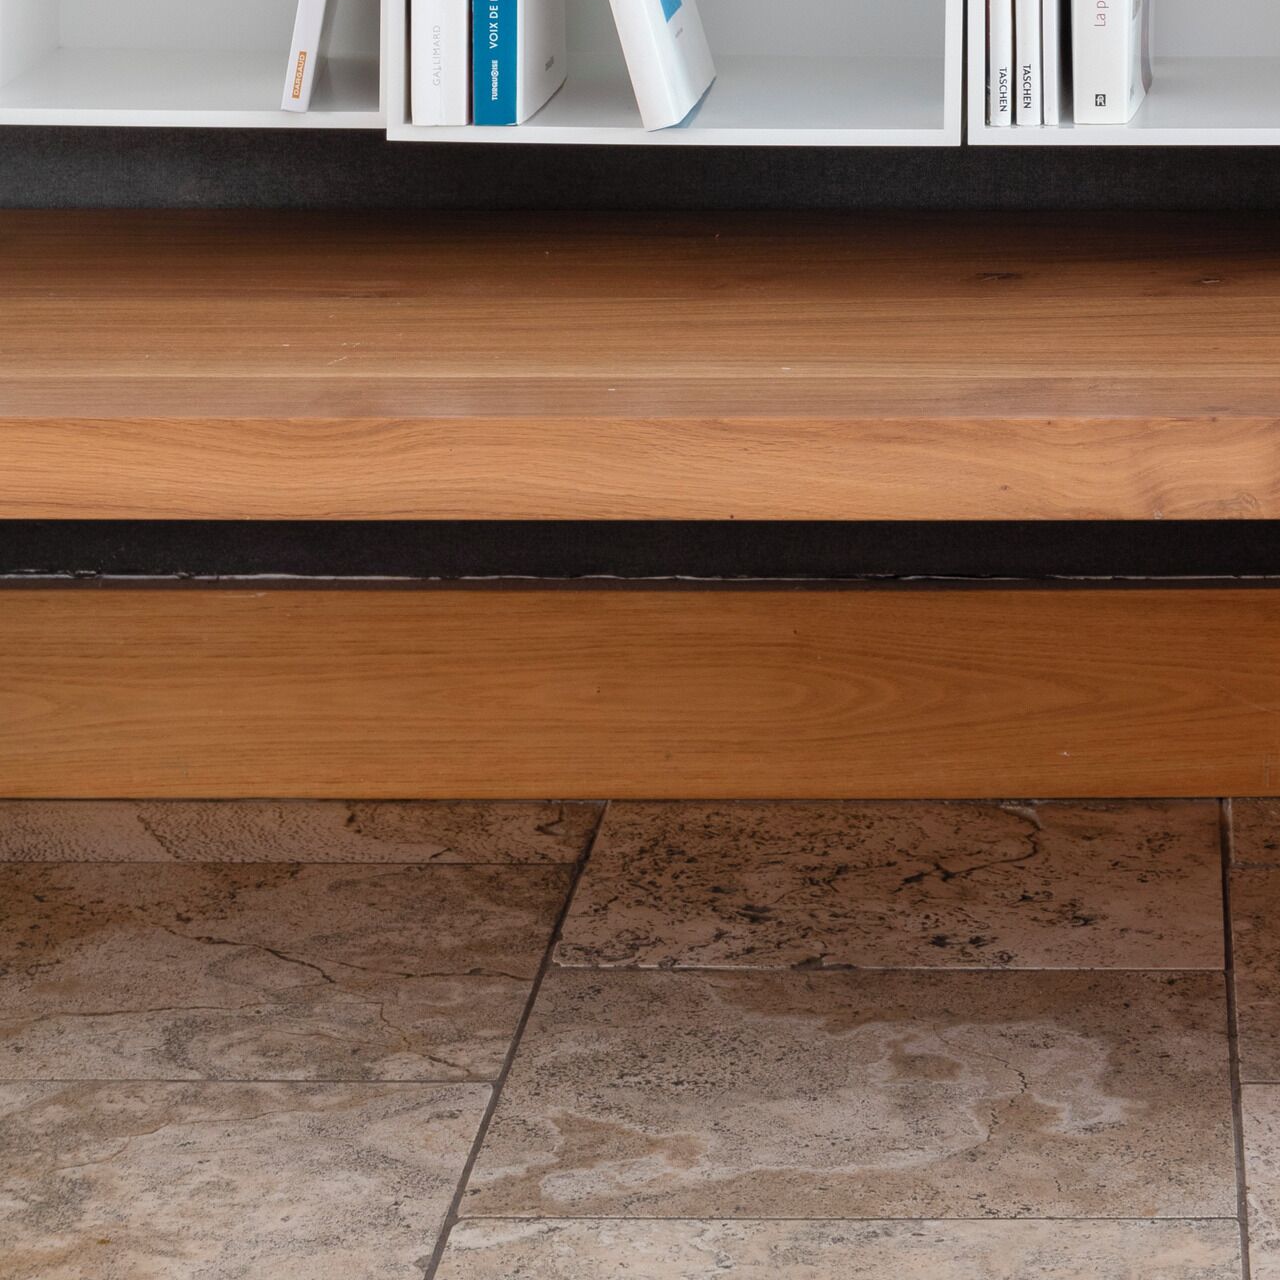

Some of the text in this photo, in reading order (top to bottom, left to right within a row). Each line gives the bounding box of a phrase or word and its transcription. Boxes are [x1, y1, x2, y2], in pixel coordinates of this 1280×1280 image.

[489, 5, 499, 19] DE
[1094, 13, 1106, 27] La
[432, 25, 441, 87] GALLIMARD
[489, 21, 499, 49] VOIX
[491, 59, 499, 101] TURQUOISE
[999, 67, 1008, 112] TASCHEN
[1023, 63, 1031, 109] TASCHEN
